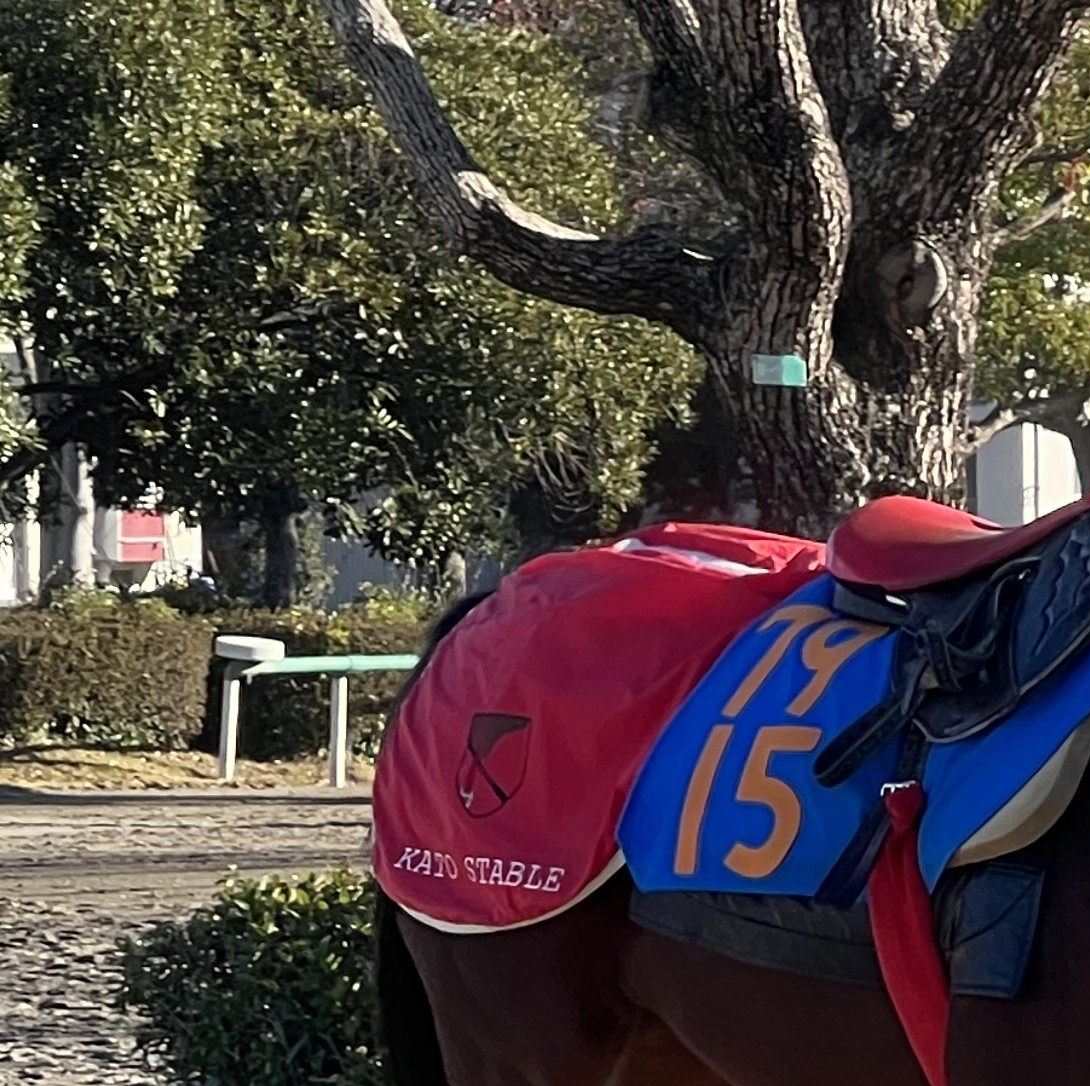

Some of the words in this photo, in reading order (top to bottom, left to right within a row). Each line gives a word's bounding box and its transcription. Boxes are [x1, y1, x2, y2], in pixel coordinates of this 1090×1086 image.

[722, 604, 890, 718] 79
[674, 723, 822, 878] 15
[394, 847, 458, 880] KATO
[463, 856, 566, 892] STABLE
